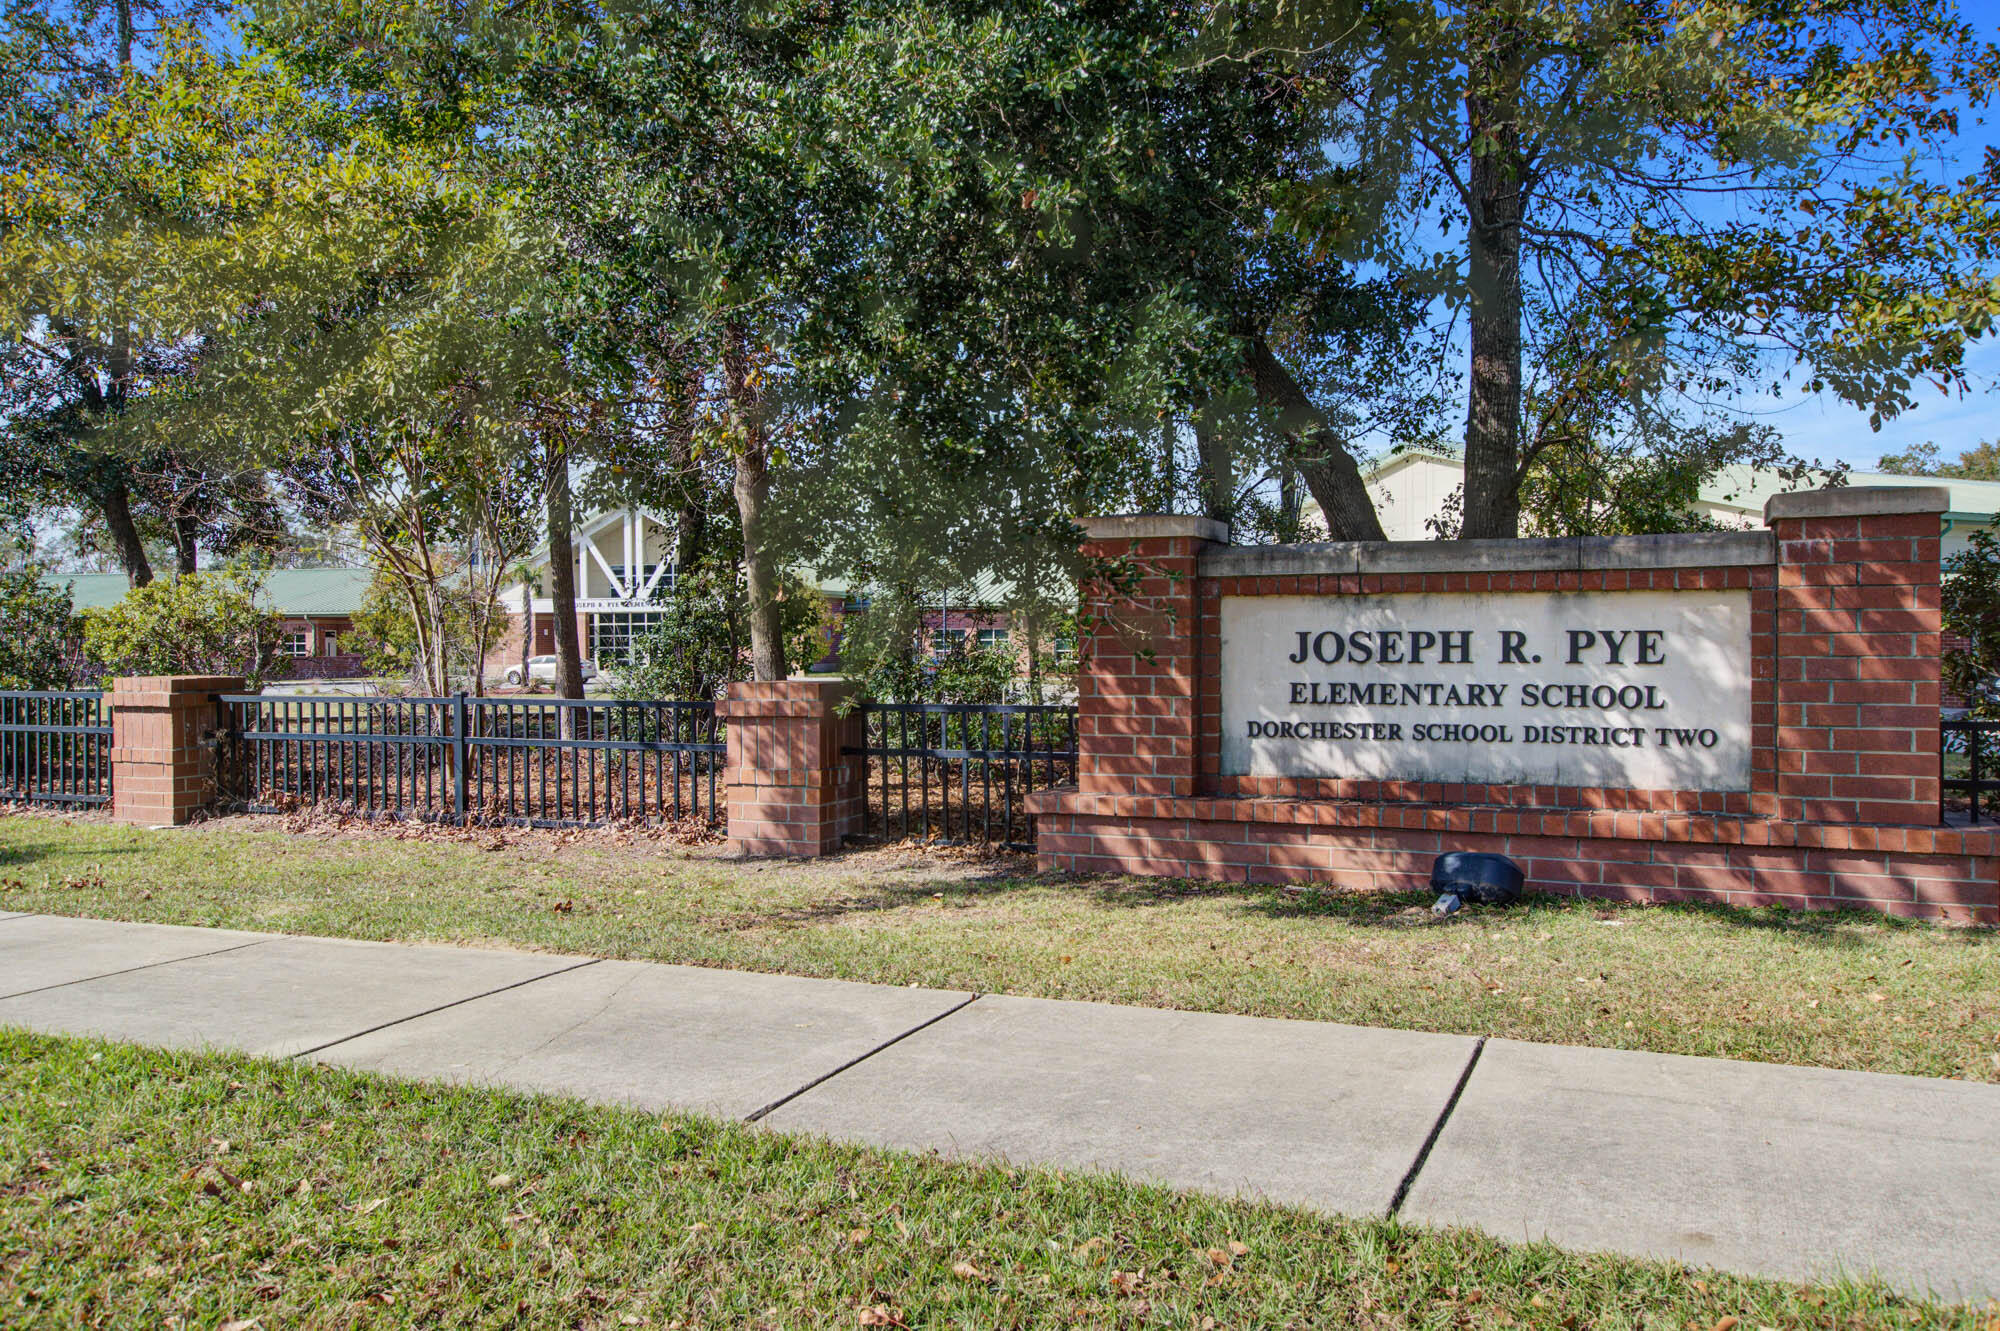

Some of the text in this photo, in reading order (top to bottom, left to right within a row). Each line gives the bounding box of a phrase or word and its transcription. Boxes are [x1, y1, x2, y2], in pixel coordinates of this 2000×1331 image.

[1288, 629, 1667, 666] JOSEPH R. PYE
[1288, 682, 1666, 711] ELEMENTARY SCHOOL
[1246, 720, 1719, 749] DORCHESTER SCHOOL DISTRICT TWO
